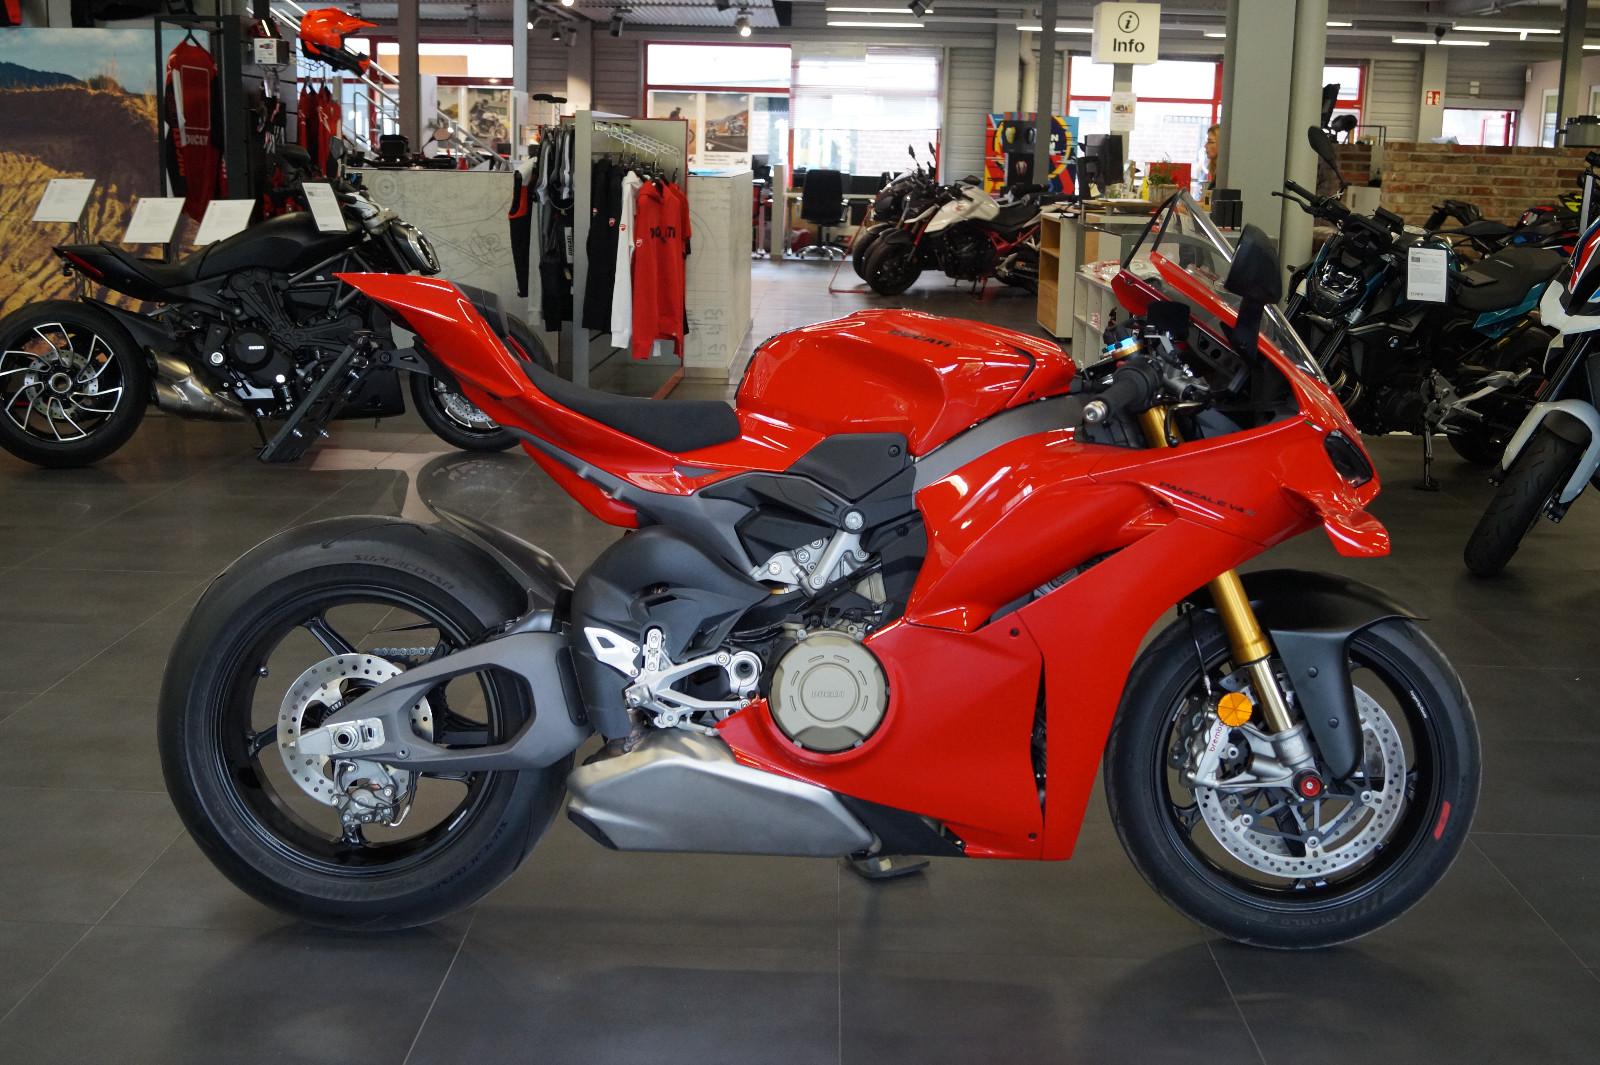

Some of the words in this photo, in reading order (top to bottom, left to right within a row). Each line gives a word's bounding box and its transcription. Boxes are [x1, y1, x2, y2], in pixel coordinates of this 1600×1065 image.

[1112, 37, 1145, 54] Info
[888, 329, 951, 347] DUCATI
[1159, 482, 1227, 506] PANIGALE
[1229, 503, 1244, 513] V4
